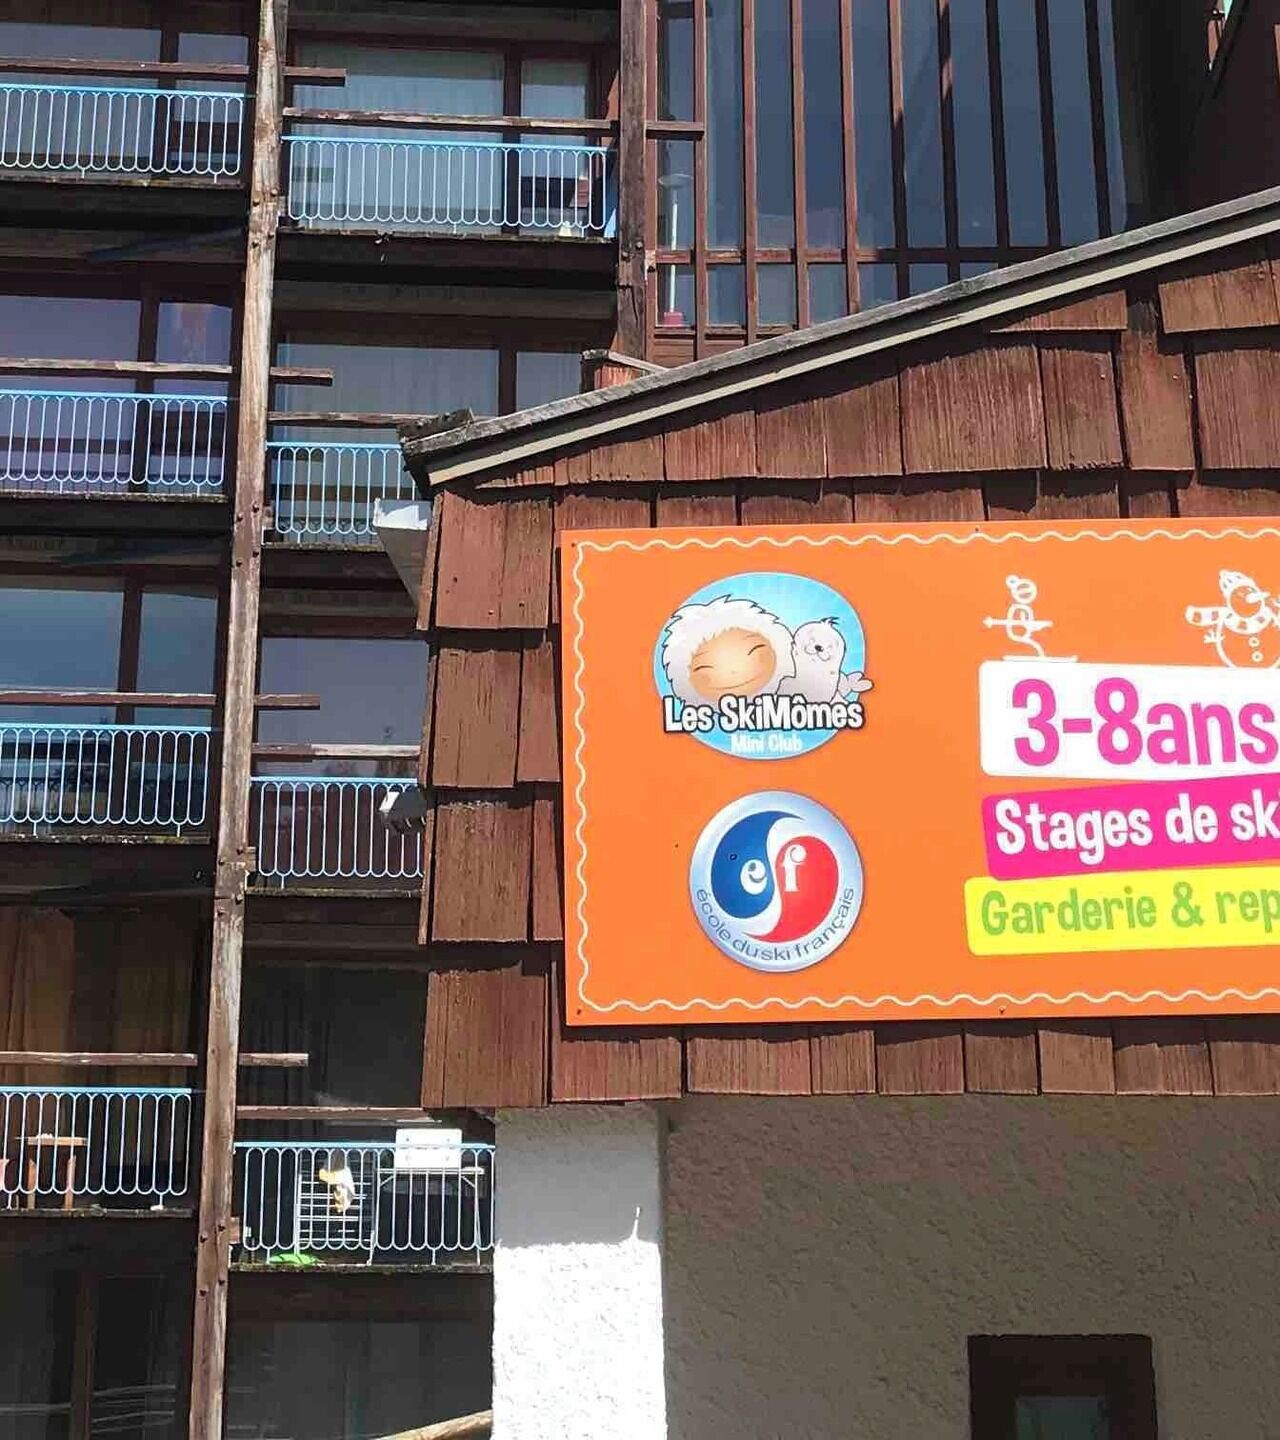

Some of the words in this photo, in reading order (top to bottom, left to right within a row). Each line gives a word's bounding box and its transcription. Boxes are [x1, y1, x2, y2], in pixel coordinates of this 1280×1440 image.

[663, 696, 714, 733] Les
[718, 693, 865, 732] SkiMômes
[1011, 678, 1279, 766] 3-8ans
[995, 799, 1153, 865] Stages
[1165, 793, 1218, 845] de
[697, 888, 731, 941] école
[793, 887, 854, 957] français
[981, 886, 1157, 935] Garderie
[1171, 882, 1204, 928] &
